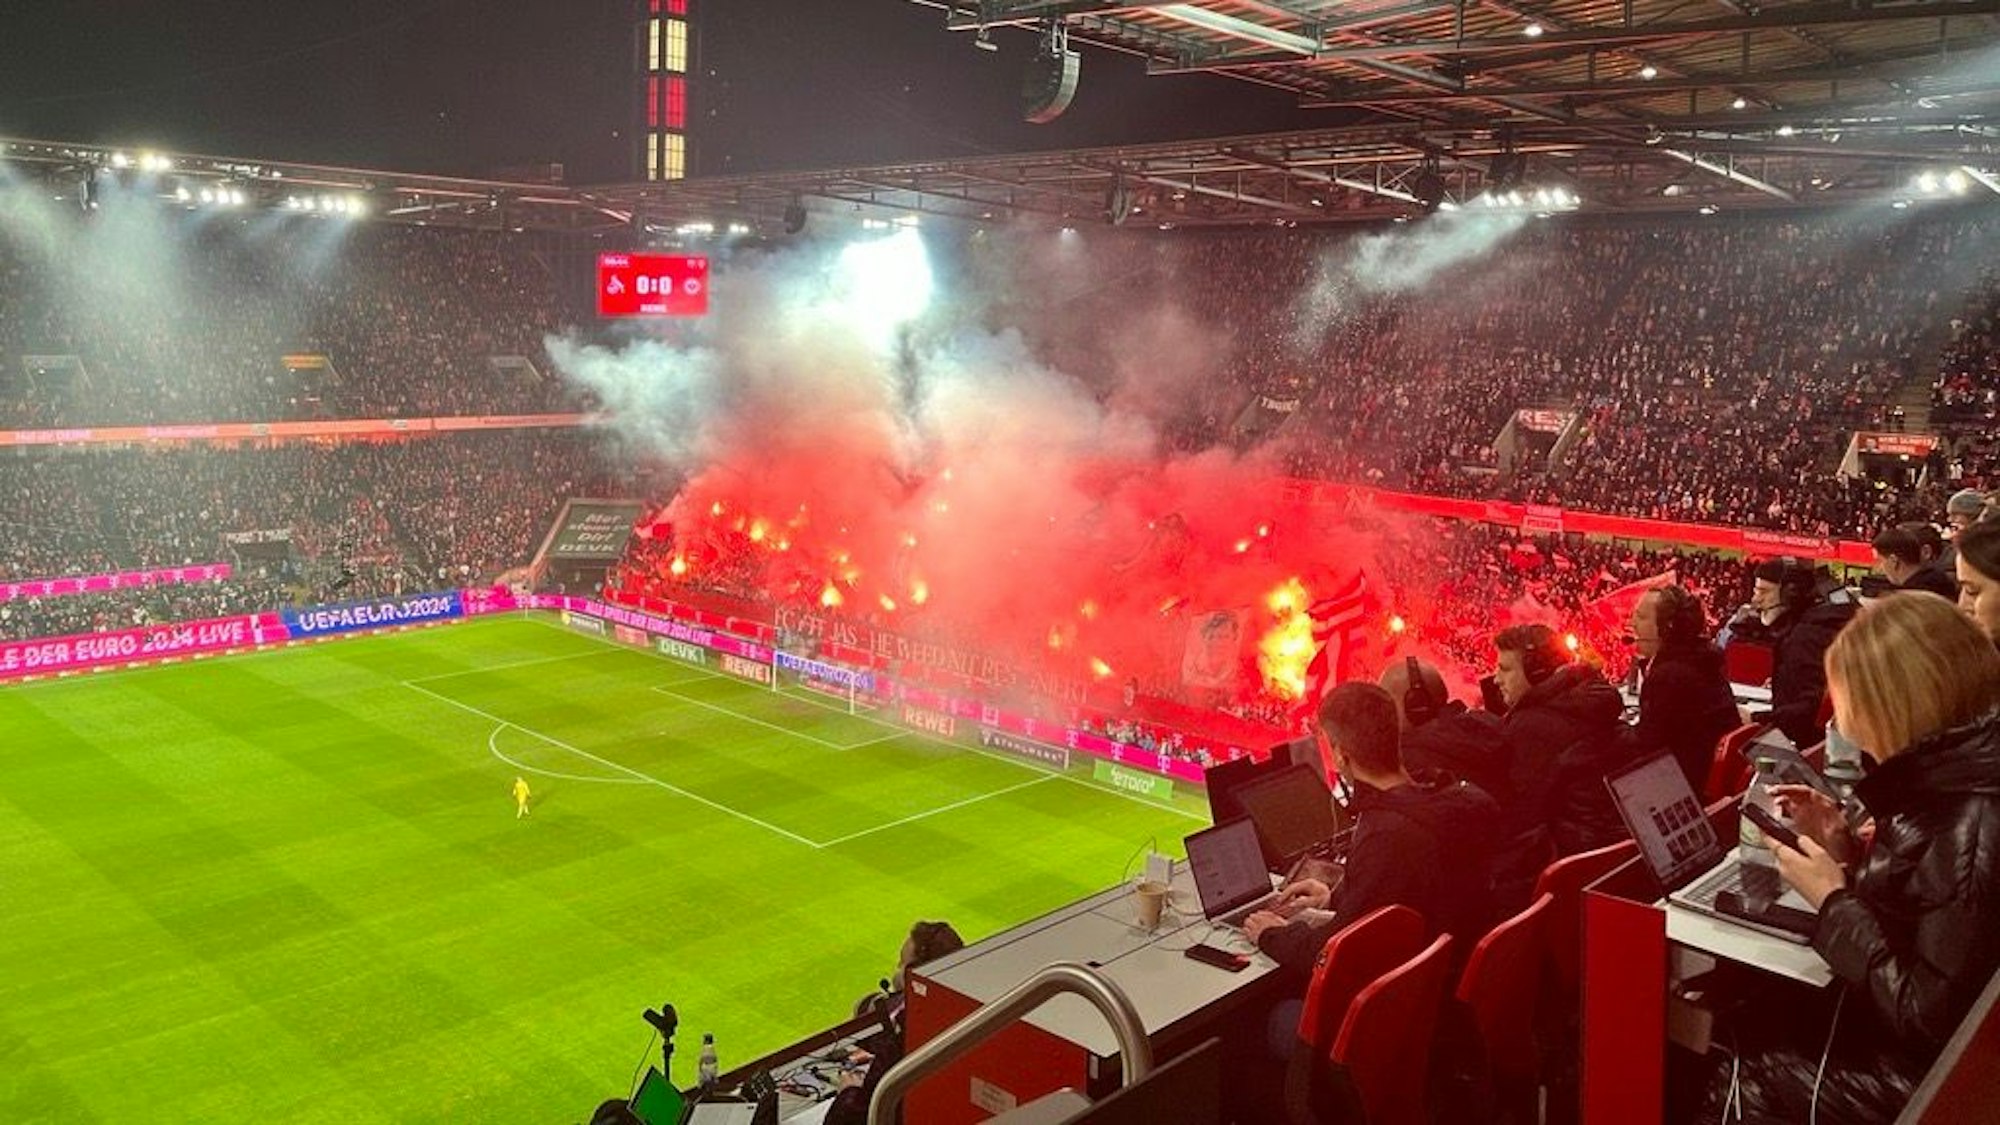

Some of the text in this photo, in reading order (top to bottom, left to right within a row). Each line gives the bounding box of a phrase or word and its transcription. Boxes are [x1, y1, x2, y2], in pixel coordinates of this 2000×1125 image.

[636, 275, 672, 295] 0:0
[559, 544, 617, 552] DEVK
[24, 642, 71, 666] DER
[75, 634, 137, 661] EURO
[143, 627, 195, 652] 2024
[199, 621, 244, 646] LIVE
[660, 639, 698, 663] DEVK
